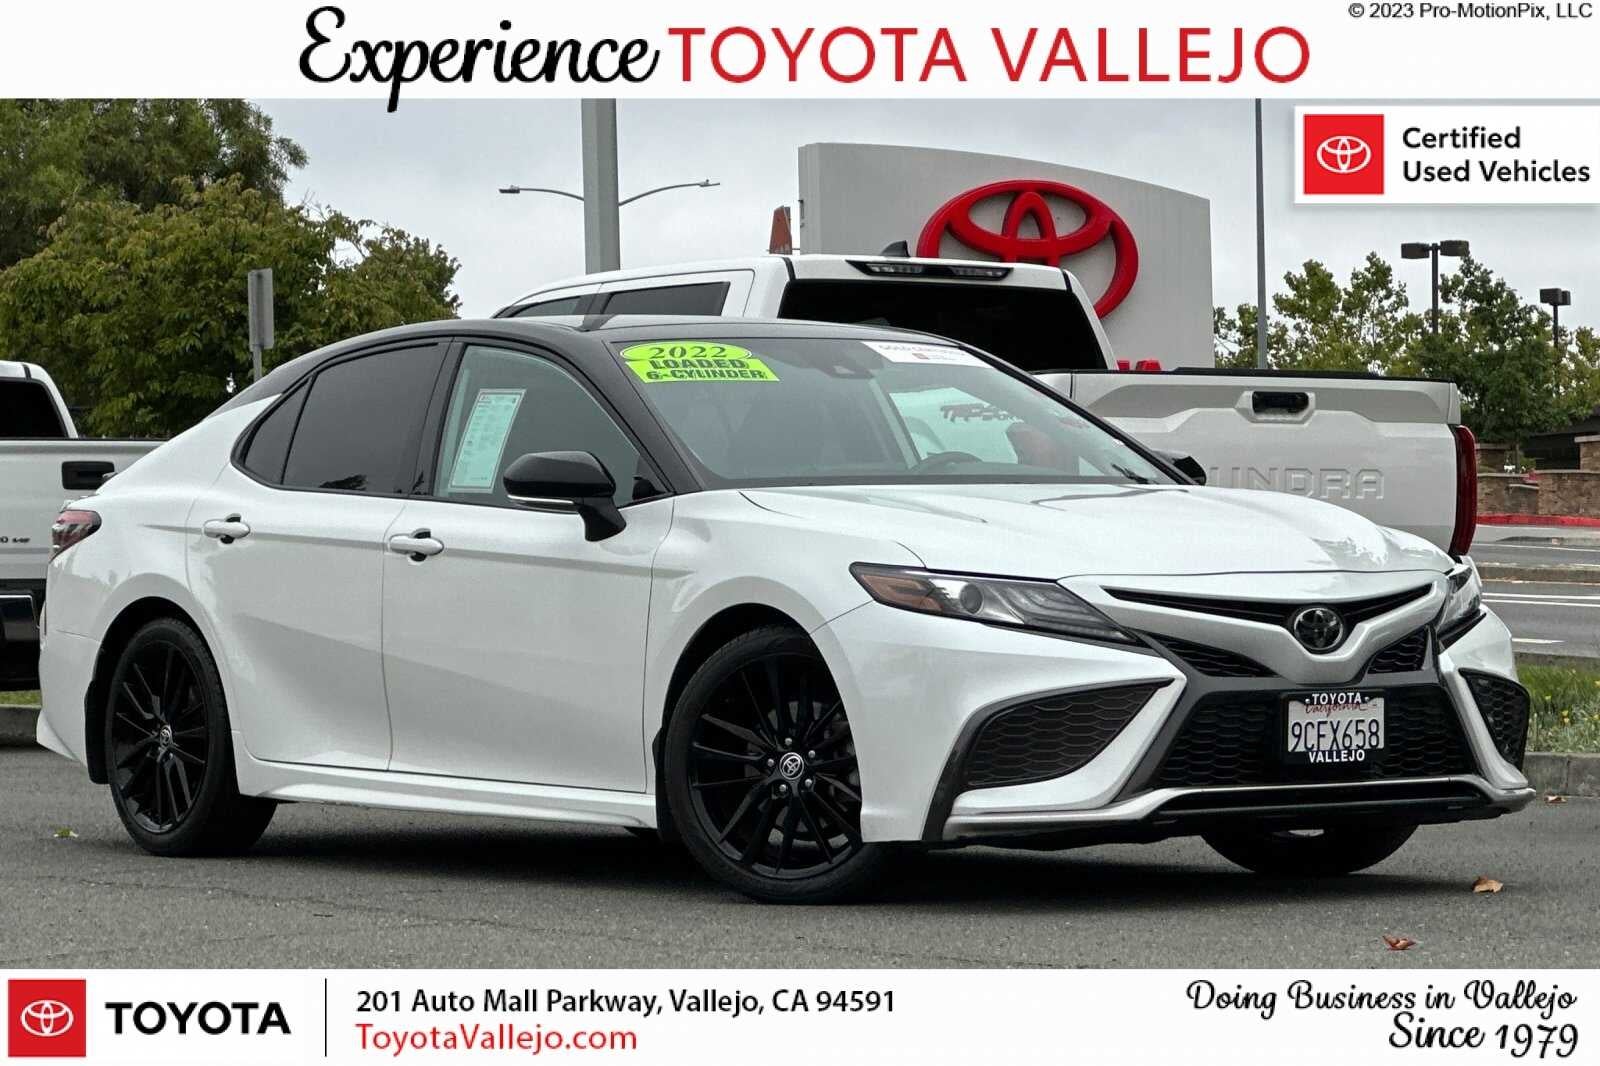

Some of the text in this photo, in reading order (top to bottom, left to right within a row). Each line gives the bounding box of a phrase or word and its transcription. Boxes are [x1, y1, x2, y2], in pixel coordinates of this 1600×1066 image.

[649, 345, 728, 359] 2022
[650, 359, 749, 370] LOADED
[646, 369, 767, 380] 6-CYLINDER
[1311, 692, 1362, 705] TOYOTA
[1290, 718, 1380, 753] 9CFX658
[1308, 749, 1366, 763] VALLEJO
